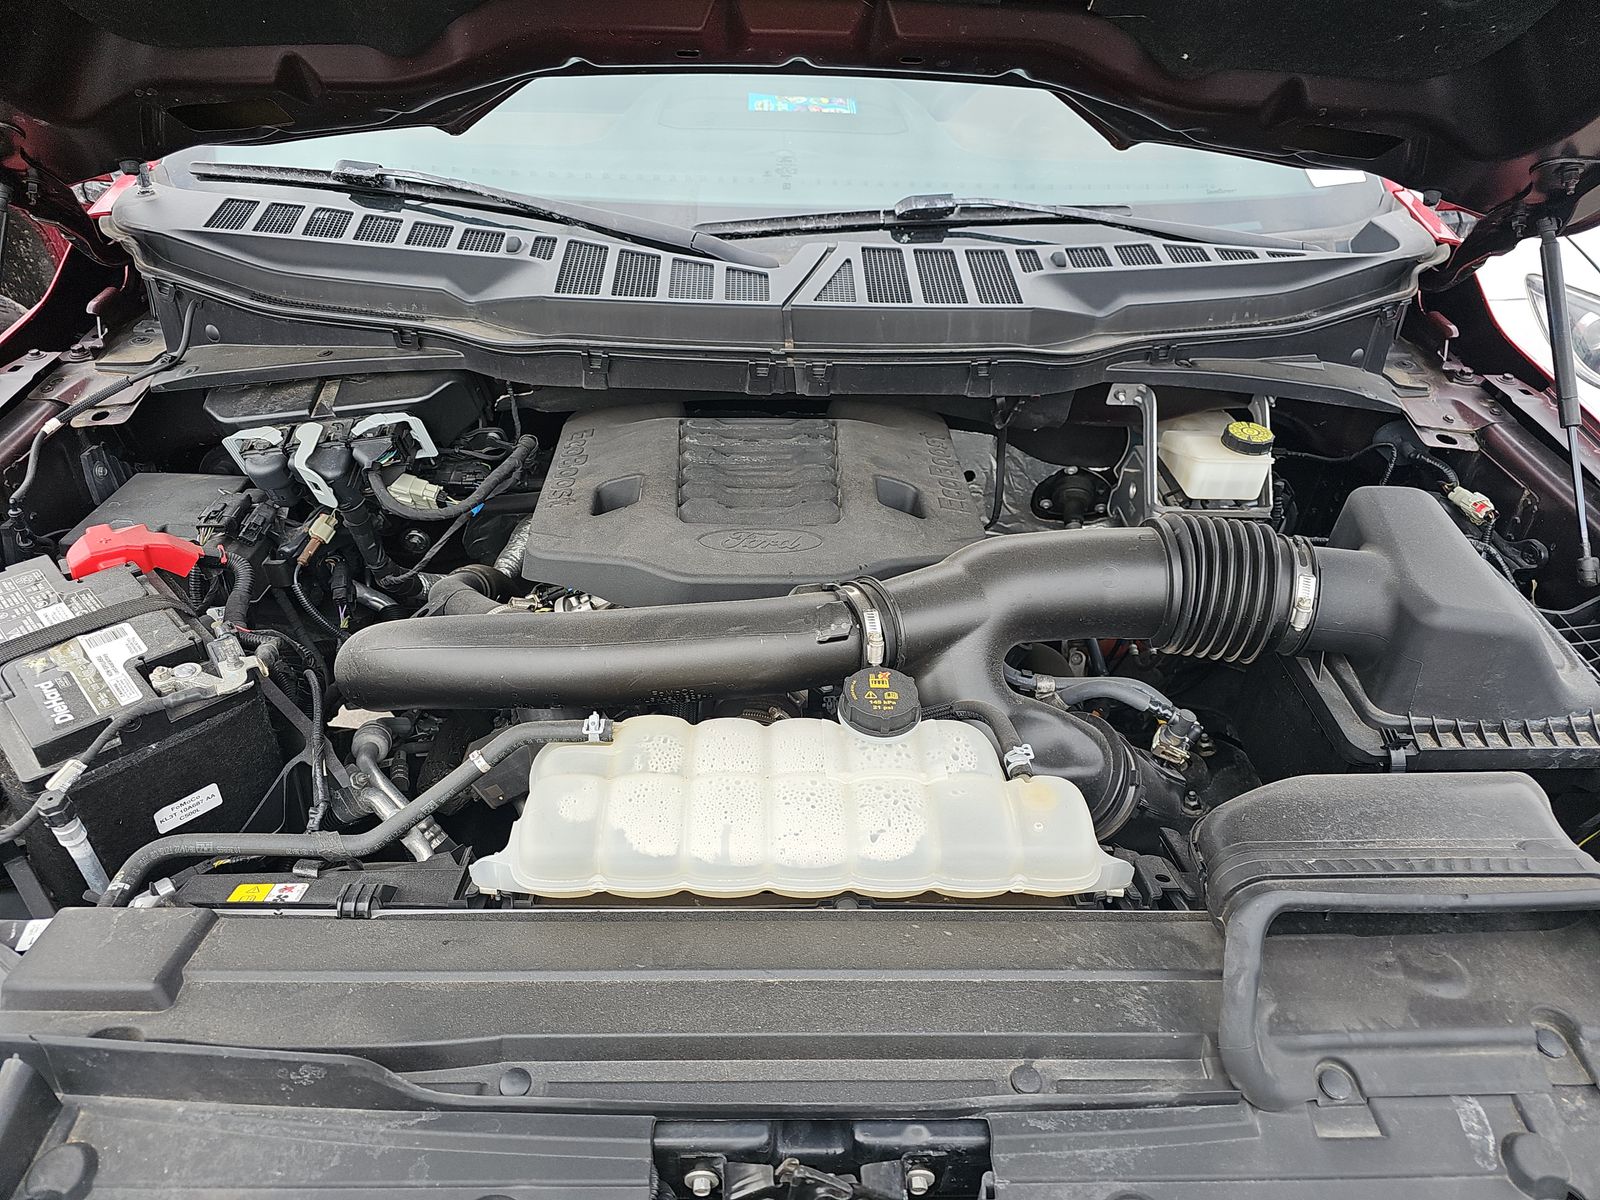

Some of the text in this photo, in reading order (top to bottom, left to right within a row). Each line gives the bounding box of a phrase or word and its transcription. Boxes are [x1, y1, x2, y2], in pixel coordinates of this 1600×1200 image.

[545, 428, 595, 508] EcoBoost
[919, 431, 972, 515] EcoBoost
[721, 531, 802, 549] Ford
[33, 680, 75, 725] DieHard
[170, 795, 201, 811] FoMoCo
[205, 793, 216, 801] AA
